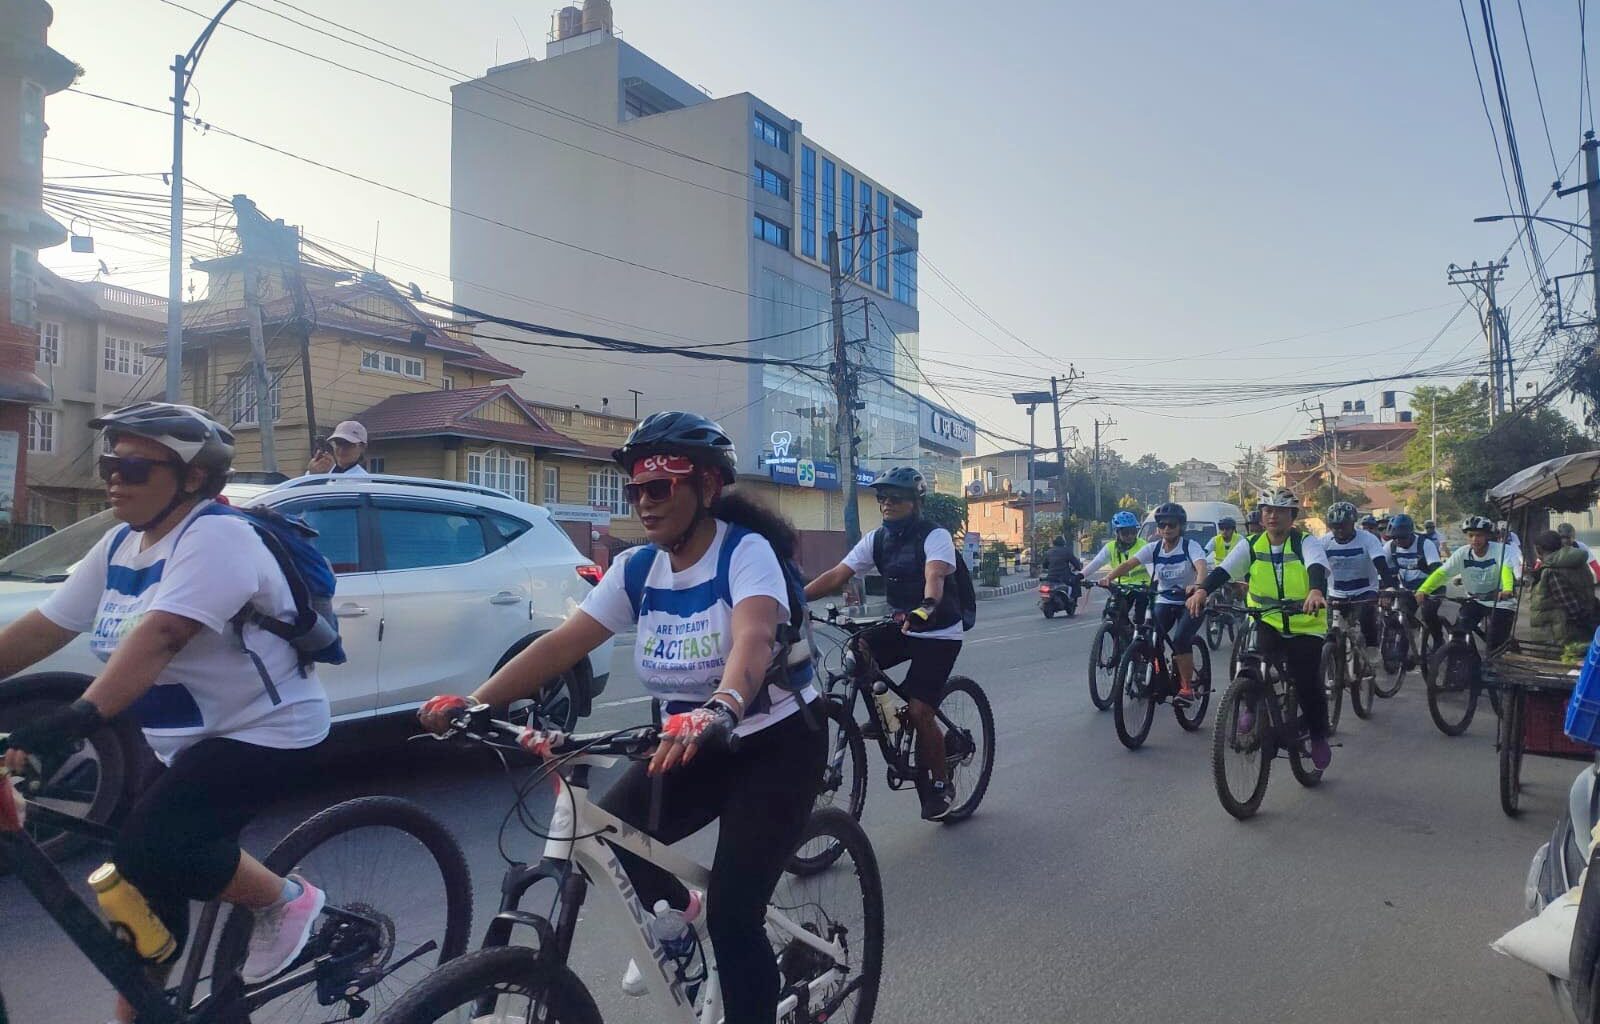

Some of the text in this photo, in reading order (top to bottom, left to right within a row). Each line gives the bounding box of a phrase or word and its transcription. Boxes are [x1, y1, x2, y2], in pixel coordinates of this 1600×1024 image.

[656, 624, 673, 635] ARE
[644, 632, 721, 660] #ACTFAST
[688, 661, 696, 671] OF
[697, 658, 726, 670] STROKE
